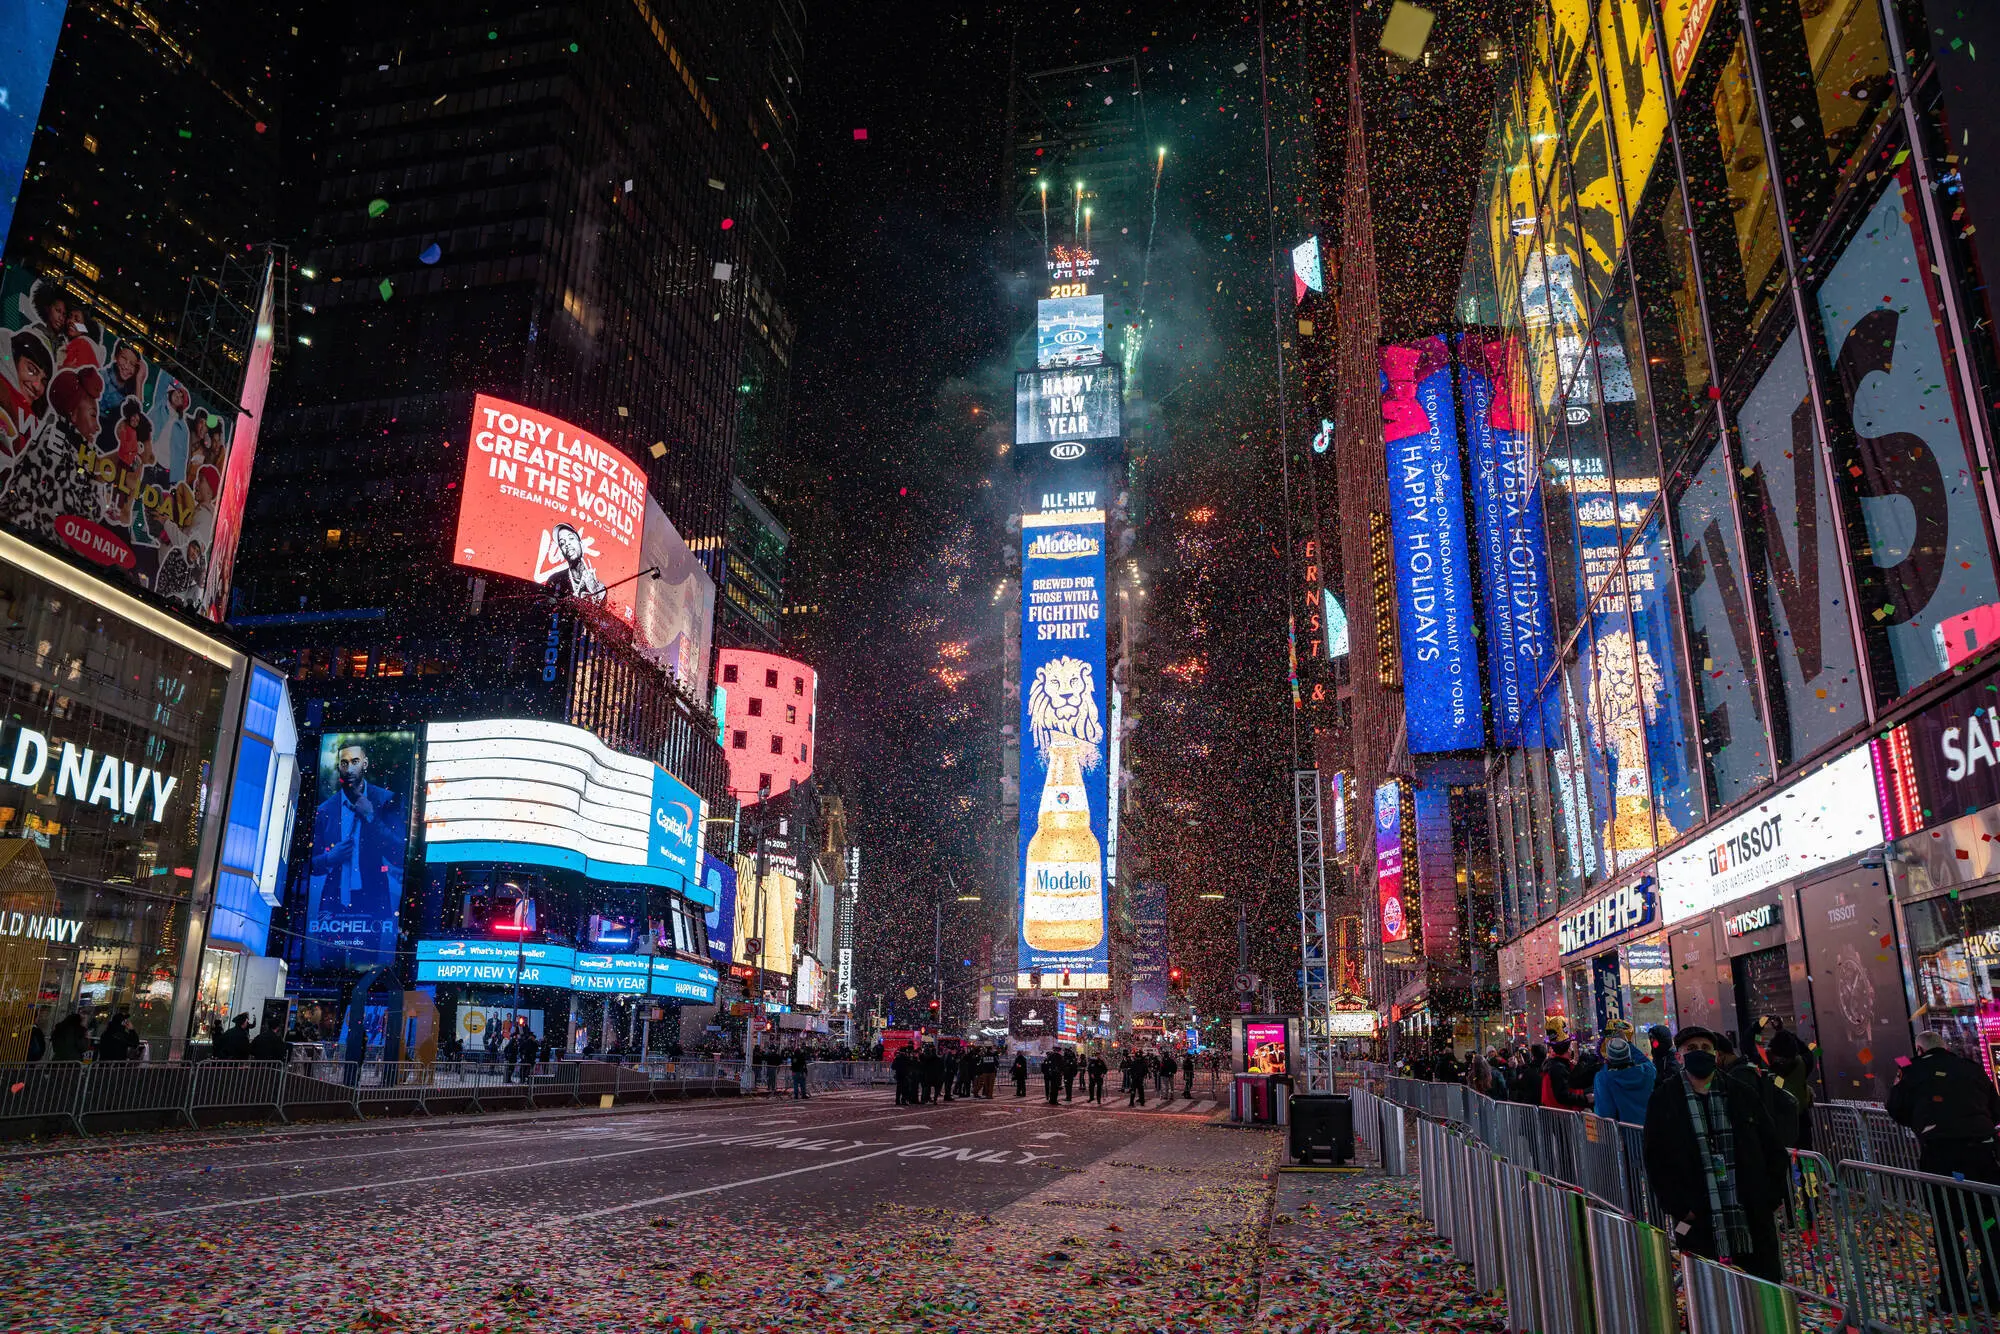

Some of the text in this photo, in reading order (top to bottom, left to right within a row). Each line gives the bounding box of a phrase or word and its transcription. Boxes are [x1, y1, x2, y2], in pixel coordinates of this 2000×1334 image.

[1056, 260, 1085, 269] stats
[1050, 283, 1087, 298] 2021
[1060, 333, 1081, 343] KIA
[1042, 375, 1093, 394] HAPPY
[1050, 396, 1085, 414] NEW
[1424, 388, 1438, 420] FROM
[1048, 416, 1088, 434] YEAR
[1429, 424, 1441, 453] OUR
[483, 407, 644, 501] TORY LANEZ THE
[1056, 446, 1080, 456] KIA
[77, 443, 195, 527] HOLIDAY
[475, 431, 643, 523] GREATEST ARTIST
[488, 457, 635, 539] IN THE WORLD.
[500, 484, 568, 514] STREAM NOW
[1042, 491, 1097, 508] ALL-NEW
[1436, 507, 1448, 526] ON
[65, 521, 129, 563] OLD NAVY
[1036, 535, 1091, 554] Modelo
[1402, 444, 1440, 662] HAPPY HOLIDAYS
[1438, 530, 1456, 601] BROADWAY
[1033, 577, 1095, 591] BREWED FOR
[1030, 589, 1098, 604] THOSE WITH A
[1306, 541, 1320, 657] ERNST
[1028, 603, 1099, 622] FIGHTING
[1037, 623, 1090, 641] SPIRIT.
[1445, 605, 1459, 658] FAMILY
[1449, 660, 1462, 675] TO
[1452, 678, 1467, 730] YOURS,
[55, 742, 178, 823] NAVY
[773, 841, 787, 849] 2020
[1727, 814, 1781, 867] TISSOT
[770, 855, 797, 866] proved
[850, 847, 860, 880] Locker
[1036, 869, 1092, 891] Modelo
[1558, 877, 1645, 957] SKECHERS
[1737, 905, 1771, 932] TISSOT
[1828, 904, 1856, 923] TISSOT
[26, 915, 83, 944] NAVY
[309, 920, 393, 933] BACHELOR
[470, 947, 494, 955] What's
[438, 965, 471, 977] HAPPY
[474, 967, 504, 978] NEW
[842, 950, 850, 981] Locker
[588, 976, 614, 988] NEW
[616, 978, 645, 990] YEAR
[897, 1144, 1065, 1165] ONLY
